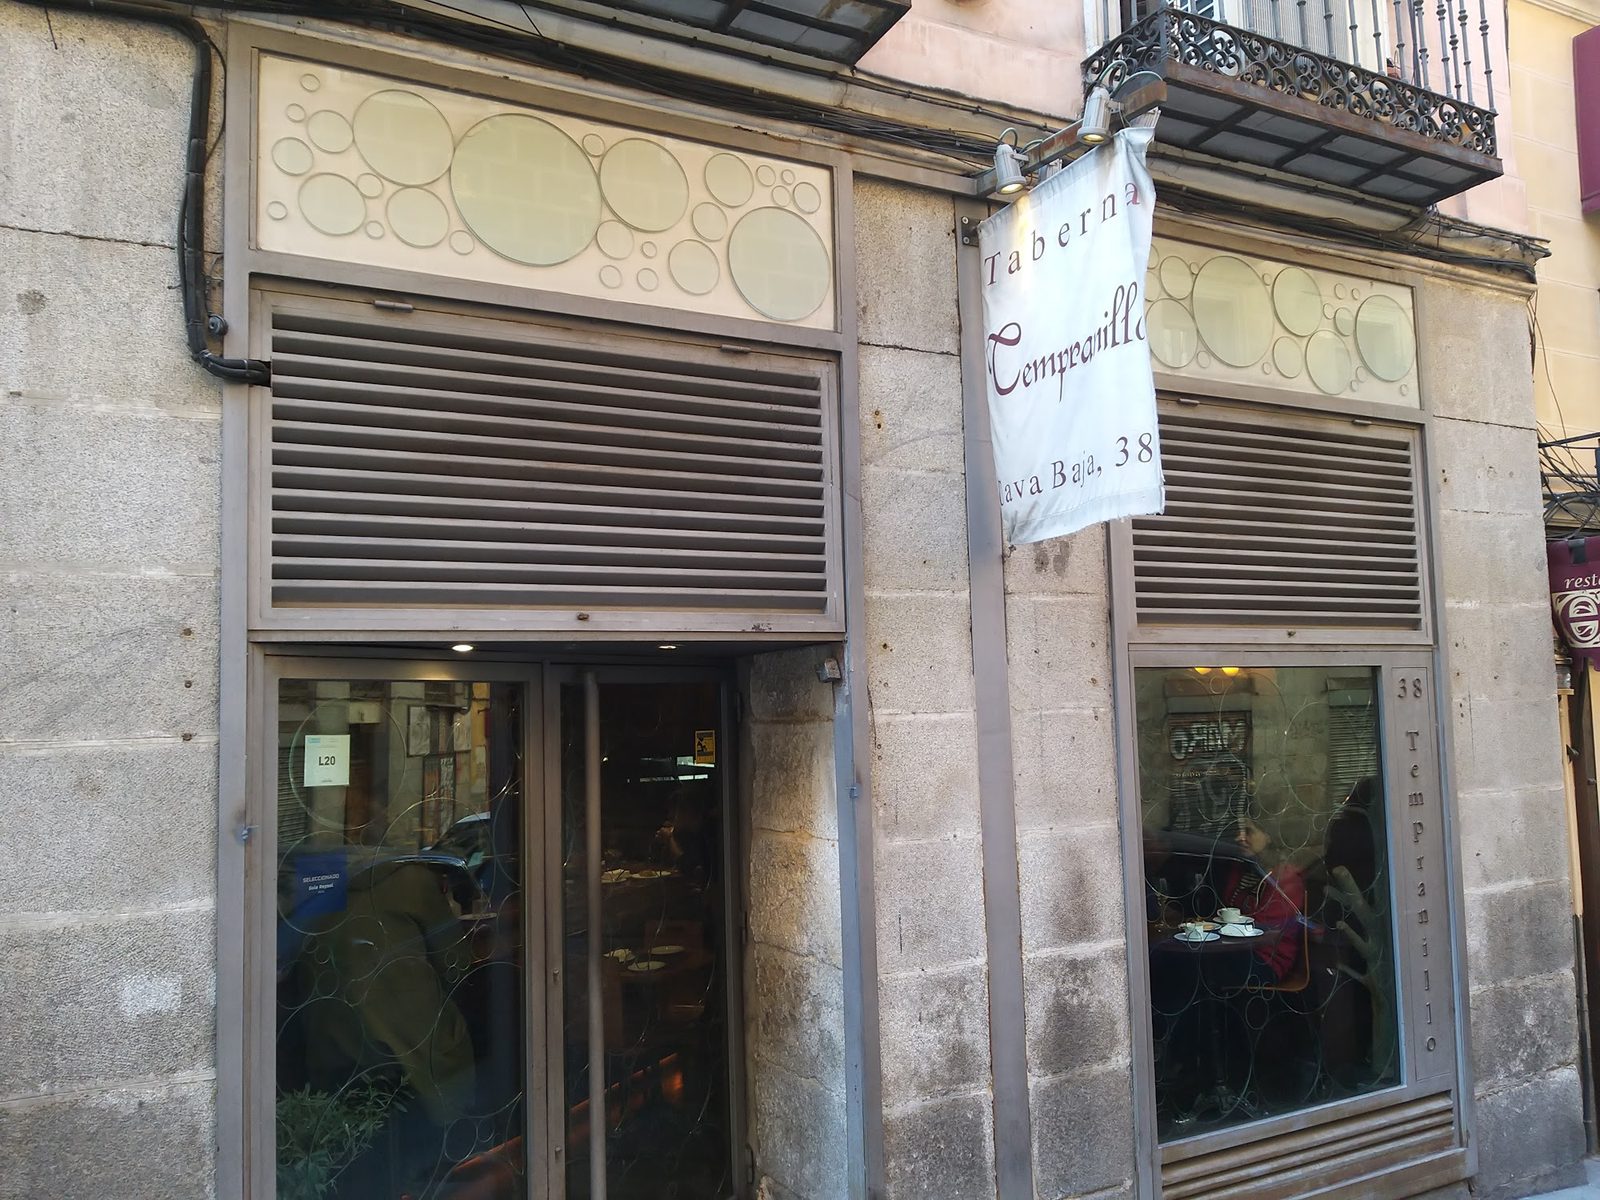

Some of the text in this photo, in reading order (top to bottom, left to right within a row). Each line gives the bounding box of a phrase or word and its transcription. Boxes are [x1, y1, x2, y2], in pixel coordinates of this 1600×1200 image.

[984, 182, 1141, 286] Taberna
[998, 432, 1154, 506] ava Baja, 38
[1397, 677, 1423, 699] 38
[318, 755, 336, 766] L20
[1406, 729, 1436, 1052] Tempranillo
